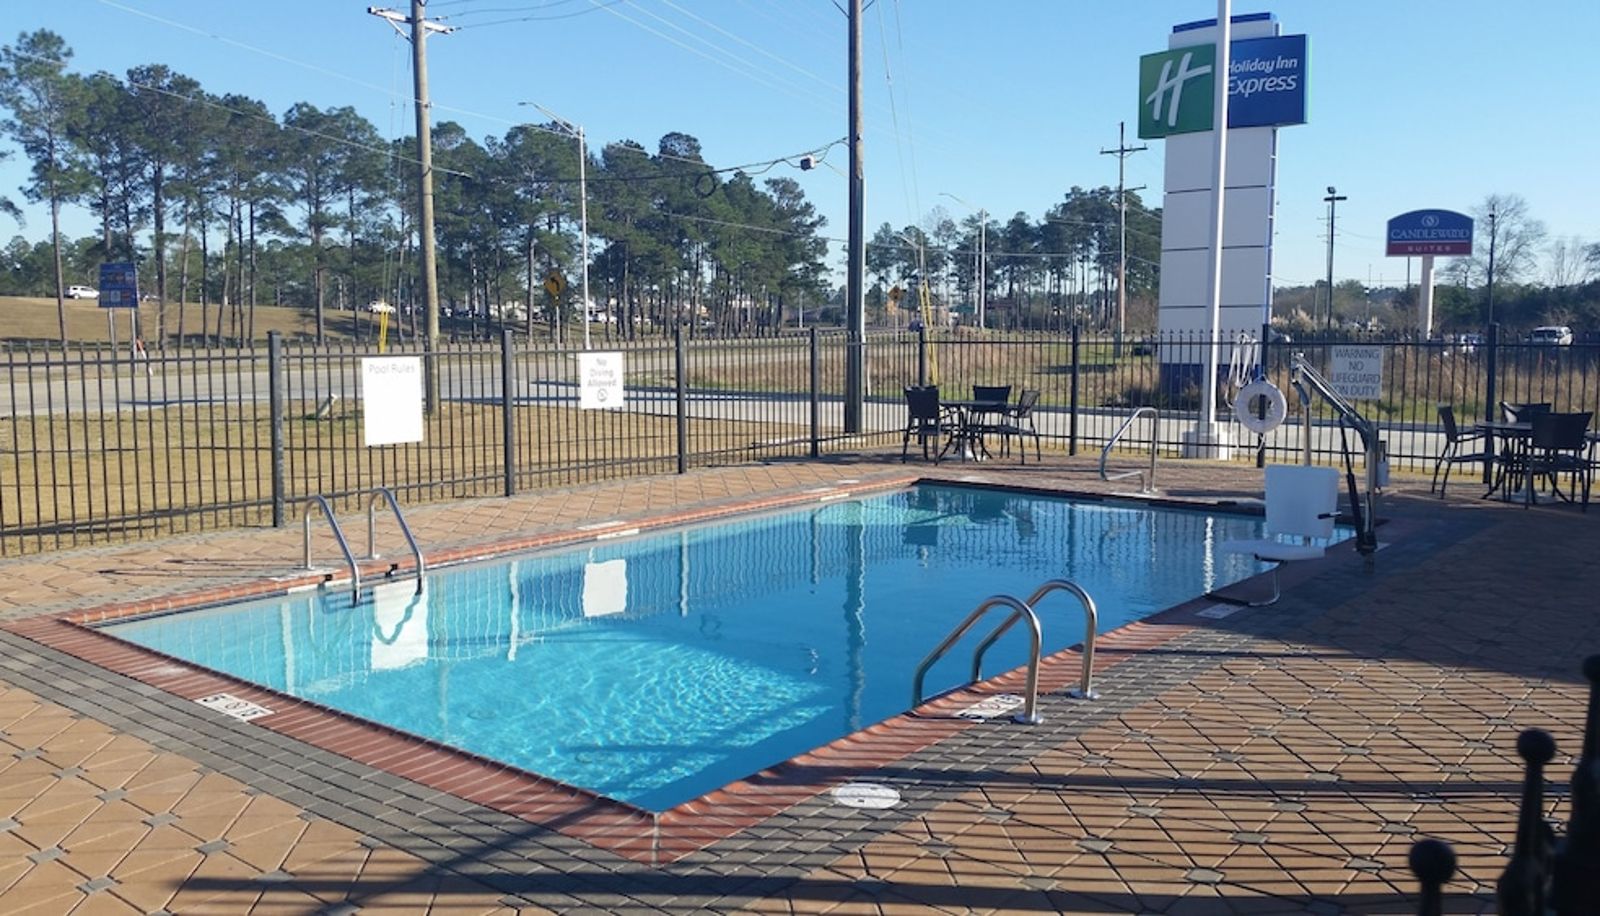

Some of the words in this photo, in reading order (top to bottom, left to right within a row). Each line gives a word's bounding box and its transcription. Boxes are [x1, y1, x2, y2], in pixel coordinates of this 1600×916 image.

[1276, 55, 1298, 69] Inn
[1228, 75, 1298, 98] Express
[1335, 348, 1380, 359] WARNING
[368, 363, 390, 374] Pool
[391, 363, 415, 374] Rules
[1348, 360, 1365, 371] NO
[1331, 372, 1381, 385] LIFEGUARD
[1350, 385, 1376, 396] DUTY
